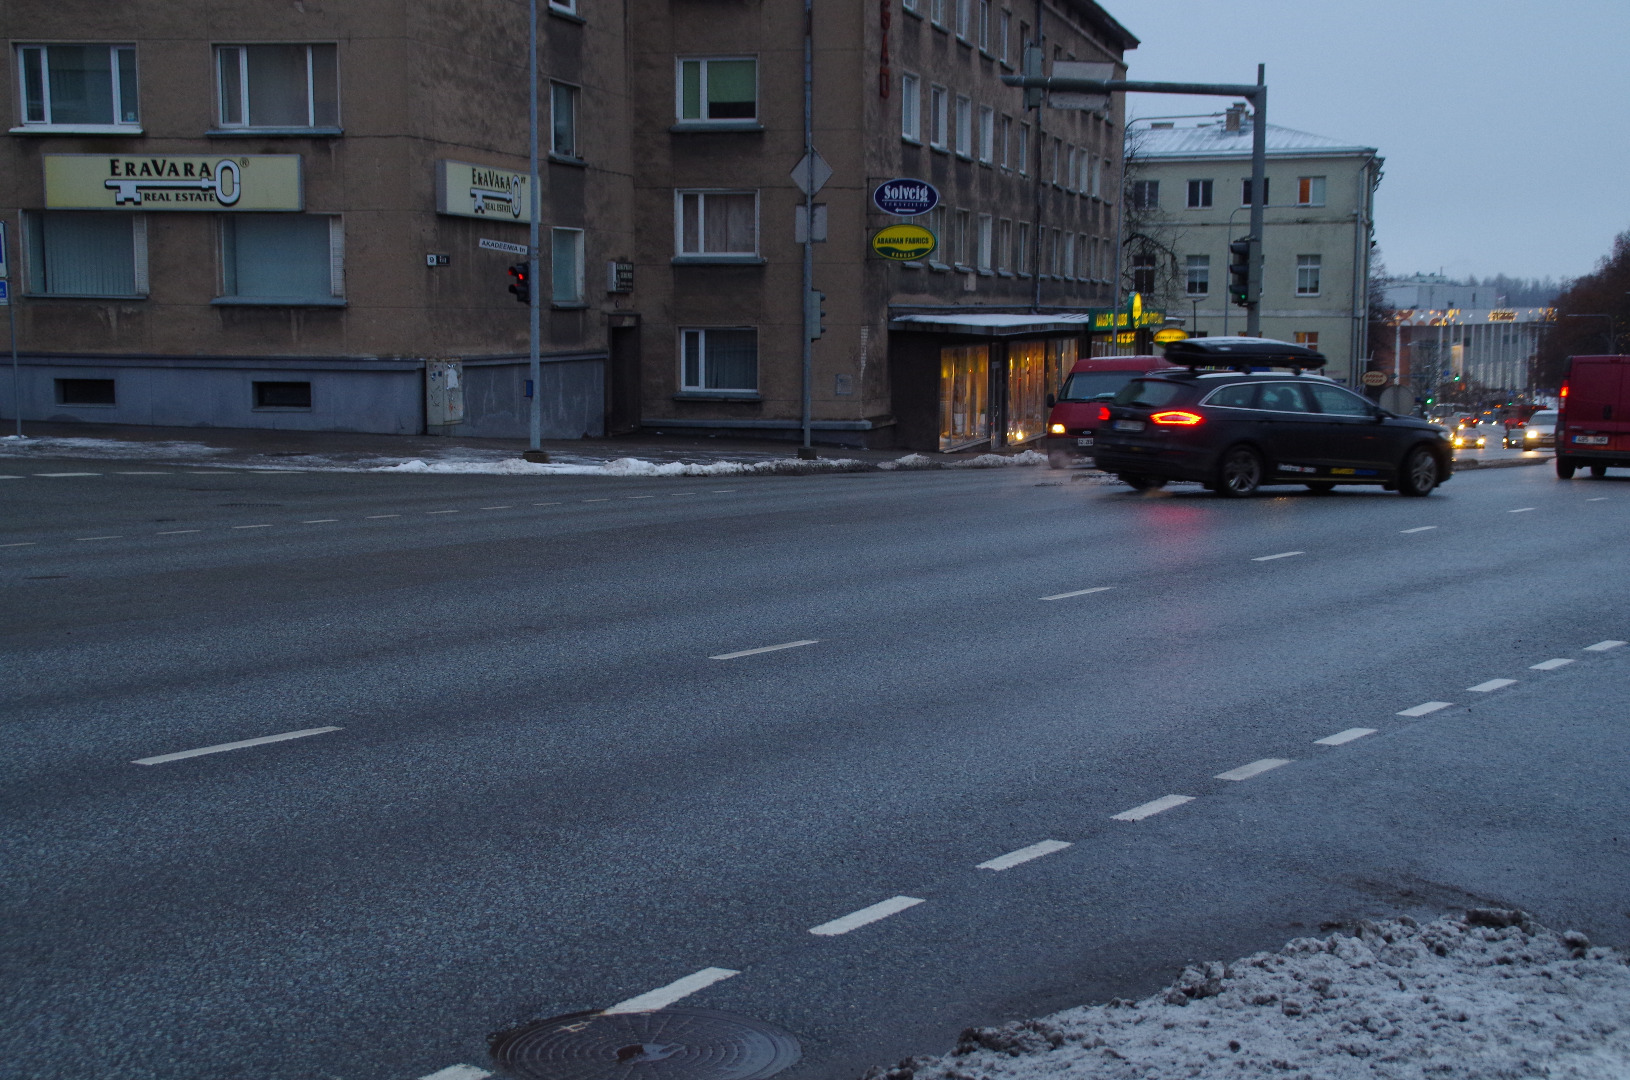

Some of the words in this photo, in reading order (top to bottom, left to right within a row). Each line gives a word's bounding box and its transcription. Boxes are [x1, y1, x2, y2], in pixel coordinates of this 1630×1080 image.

[144, 192, 171, 201] REAL
[175, 192, 215, 202] ESTATE
[884, 184, 929, 202] Solveig
[481, 240, 519, 252] AKADEEMIA
